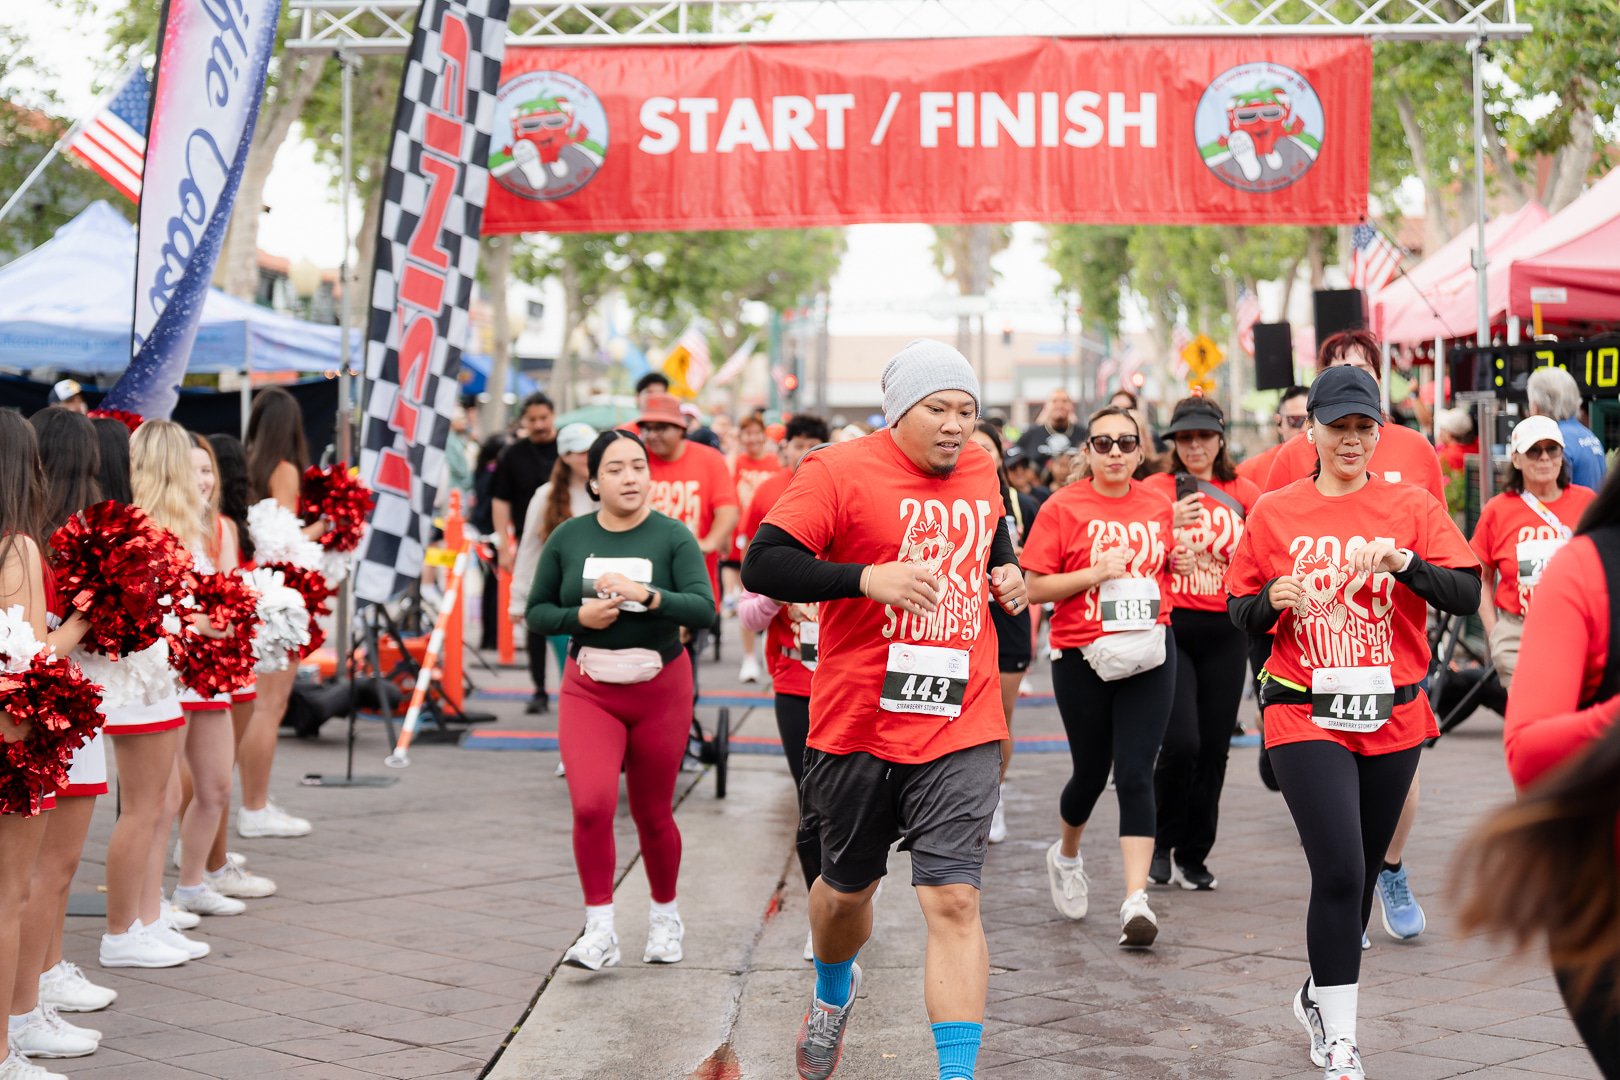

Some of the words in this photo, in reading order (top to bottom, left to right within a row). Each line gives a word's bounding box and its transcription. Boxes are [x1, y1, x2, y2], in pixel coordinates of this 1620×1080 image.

[638, 93, 855, 155] START
[870, 91, 901, 146] /
[919, 90, 1158, 148] FINISH
[898, 498, 993, 593] 2025
[1087, 519, 1165, 578] 2025
[1289, 535, 1396, 619] 2025
[881, 602, 960, 641] STOMP
[1115, 599, 1152, 620] 685
[1294, 615, 1365, 668] STOMP
[1370, 640, 1395, 665] 5K
[896, 703, 923, 711] STRAWBERRY
[900, 674, 951, 703] 443
[1329, 694, 1379, 720] 444
[1328, 720, 1357, 728] STRAWBERRY
